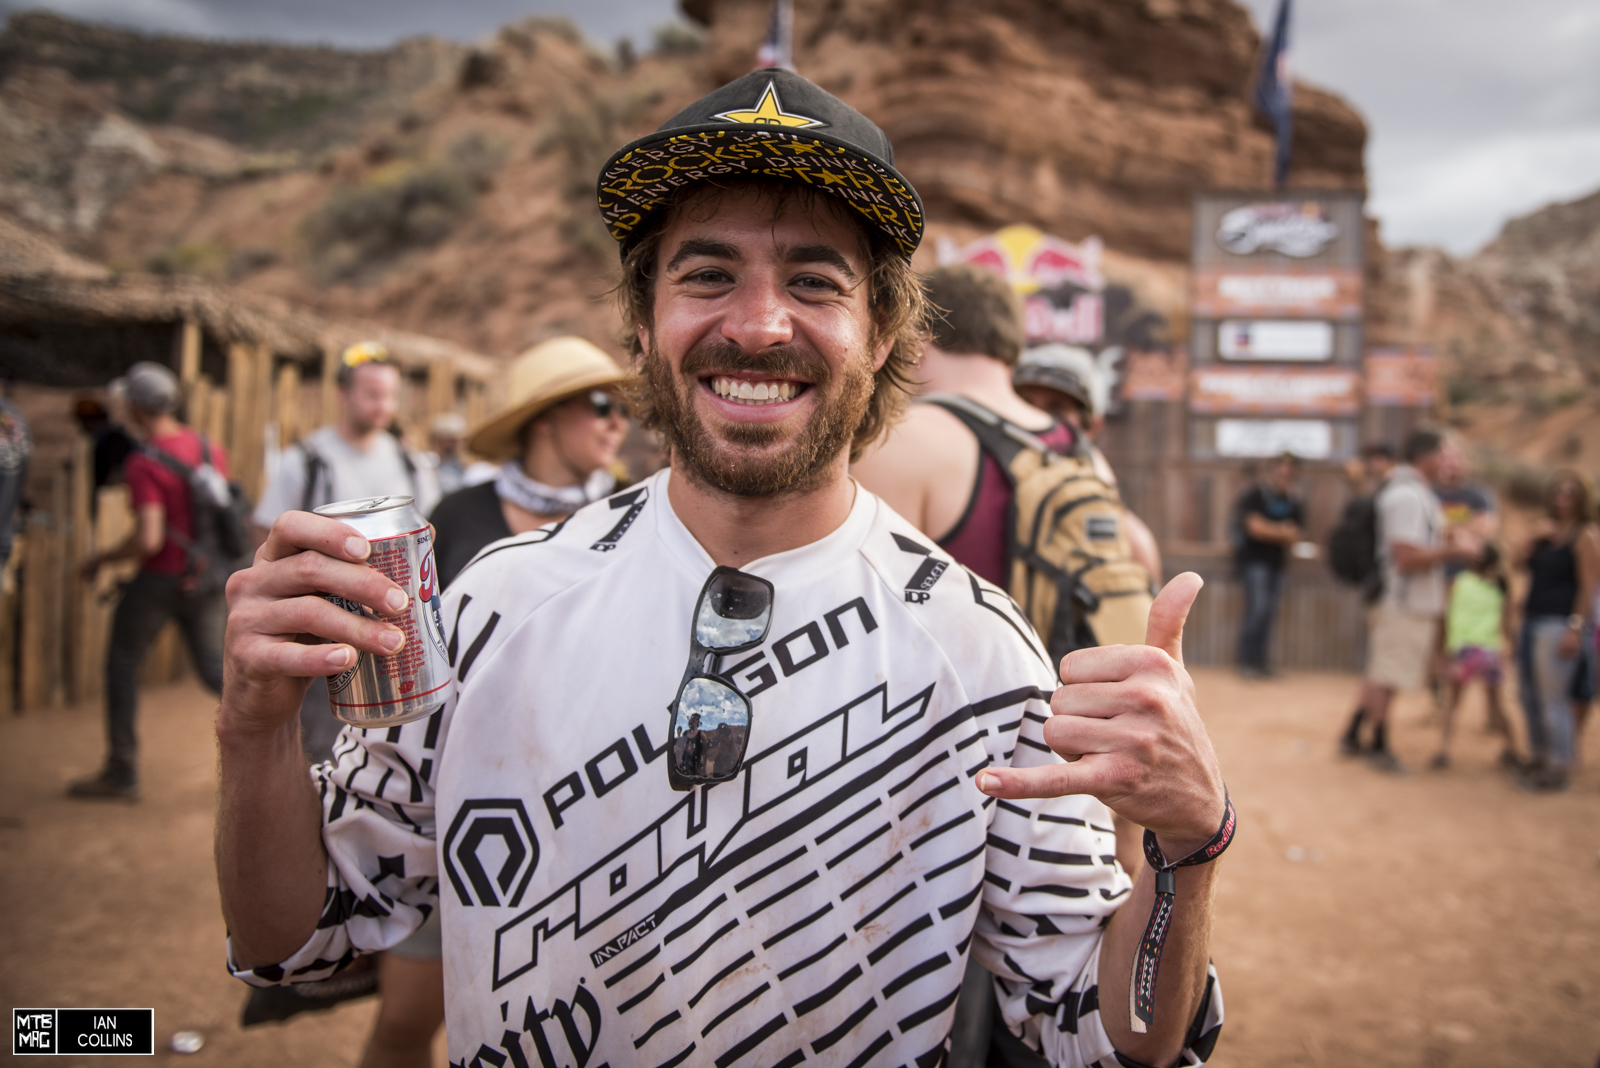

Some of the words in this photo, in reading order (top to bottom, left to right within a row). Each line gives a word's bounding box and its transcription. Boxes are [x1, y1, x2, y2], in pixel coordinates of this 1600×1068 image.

[626, 160, 748, 205] ENERGY
[765, 156, 865, 171] DRINK
[1206, 828, 1230, 858] Red
[594, 913, 656, 965] IMPACT
